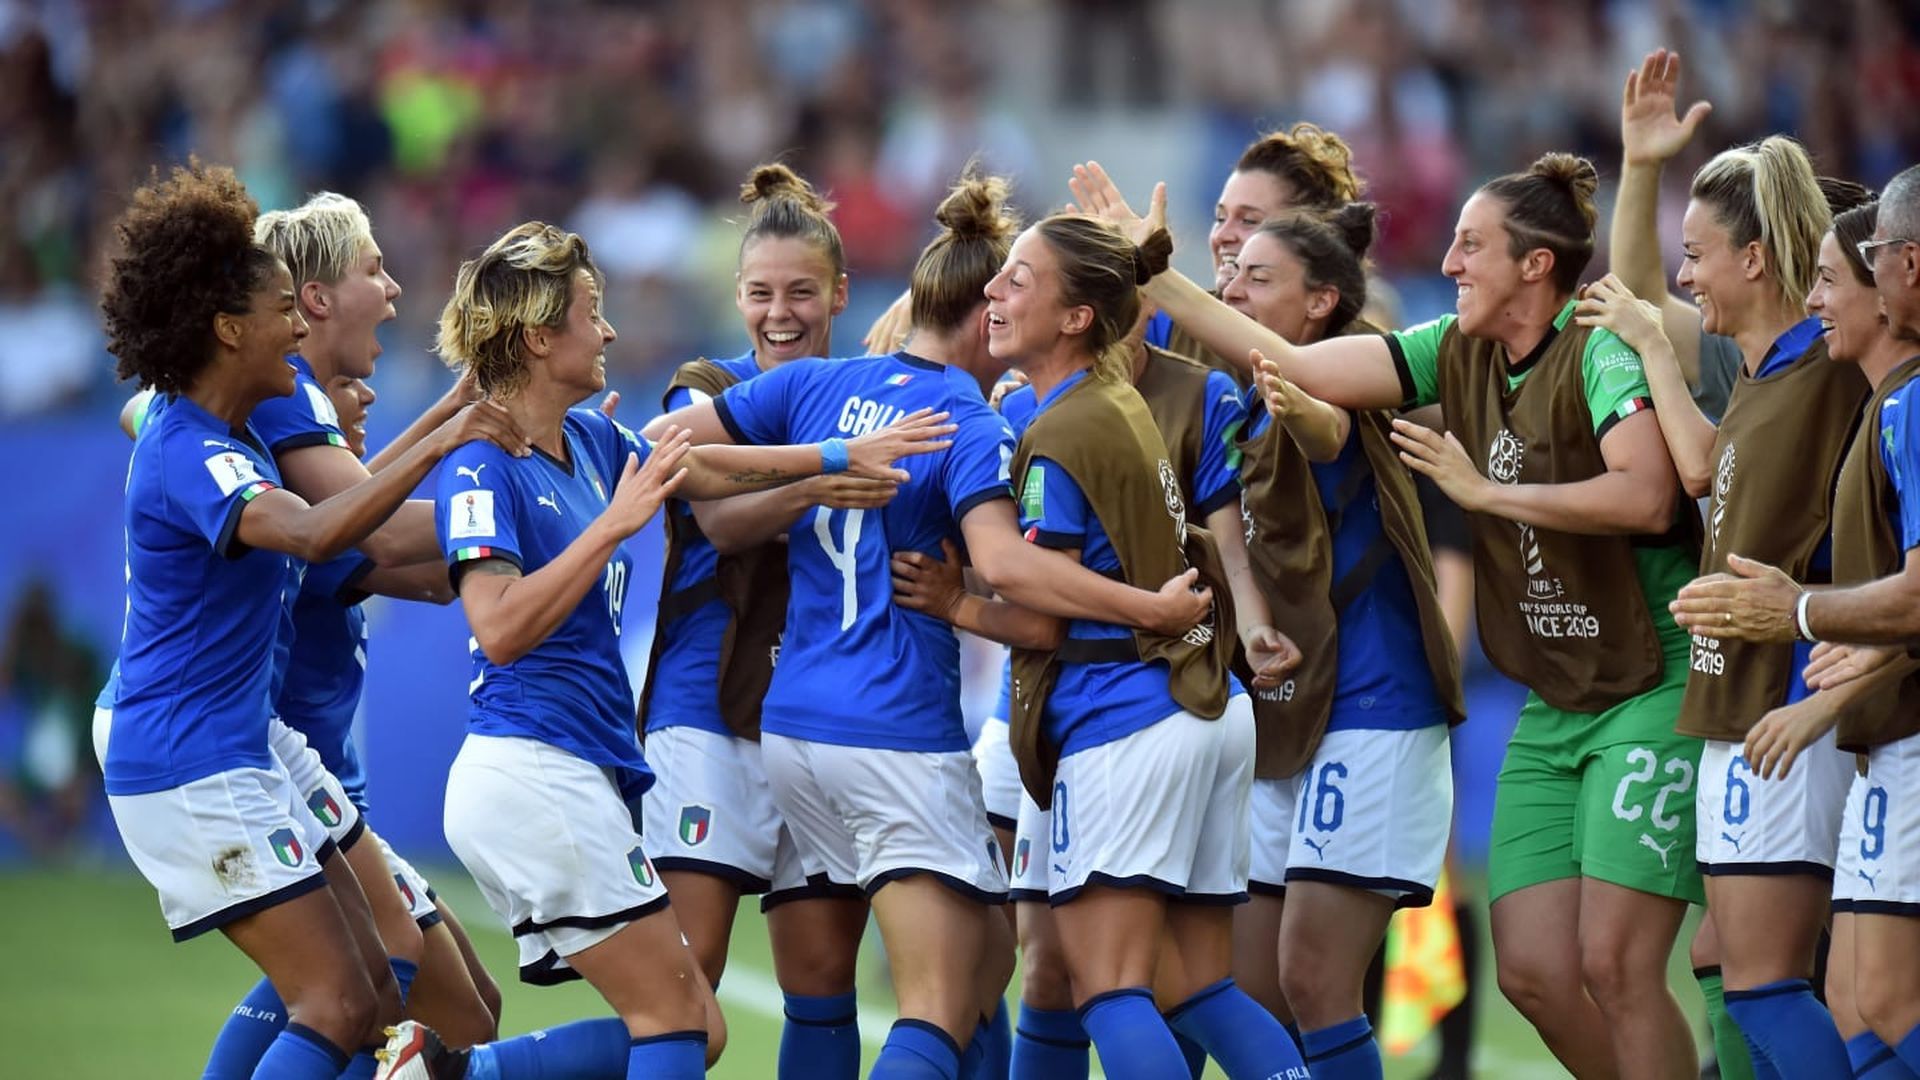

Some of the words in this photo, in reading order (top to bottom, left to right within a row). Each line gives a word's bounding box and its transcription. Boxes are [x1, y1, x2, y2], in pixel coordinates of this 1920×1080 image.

[1563, 616, 1600, 638] 2019
[1693, 648, 1725, 676] 2019
[1298, 761, 1349, 833] 16
[1612, 747, 1694, 831] 22
[1723, 755, 1751, 826] 6
[1861, 785, 1888, 861] 9
